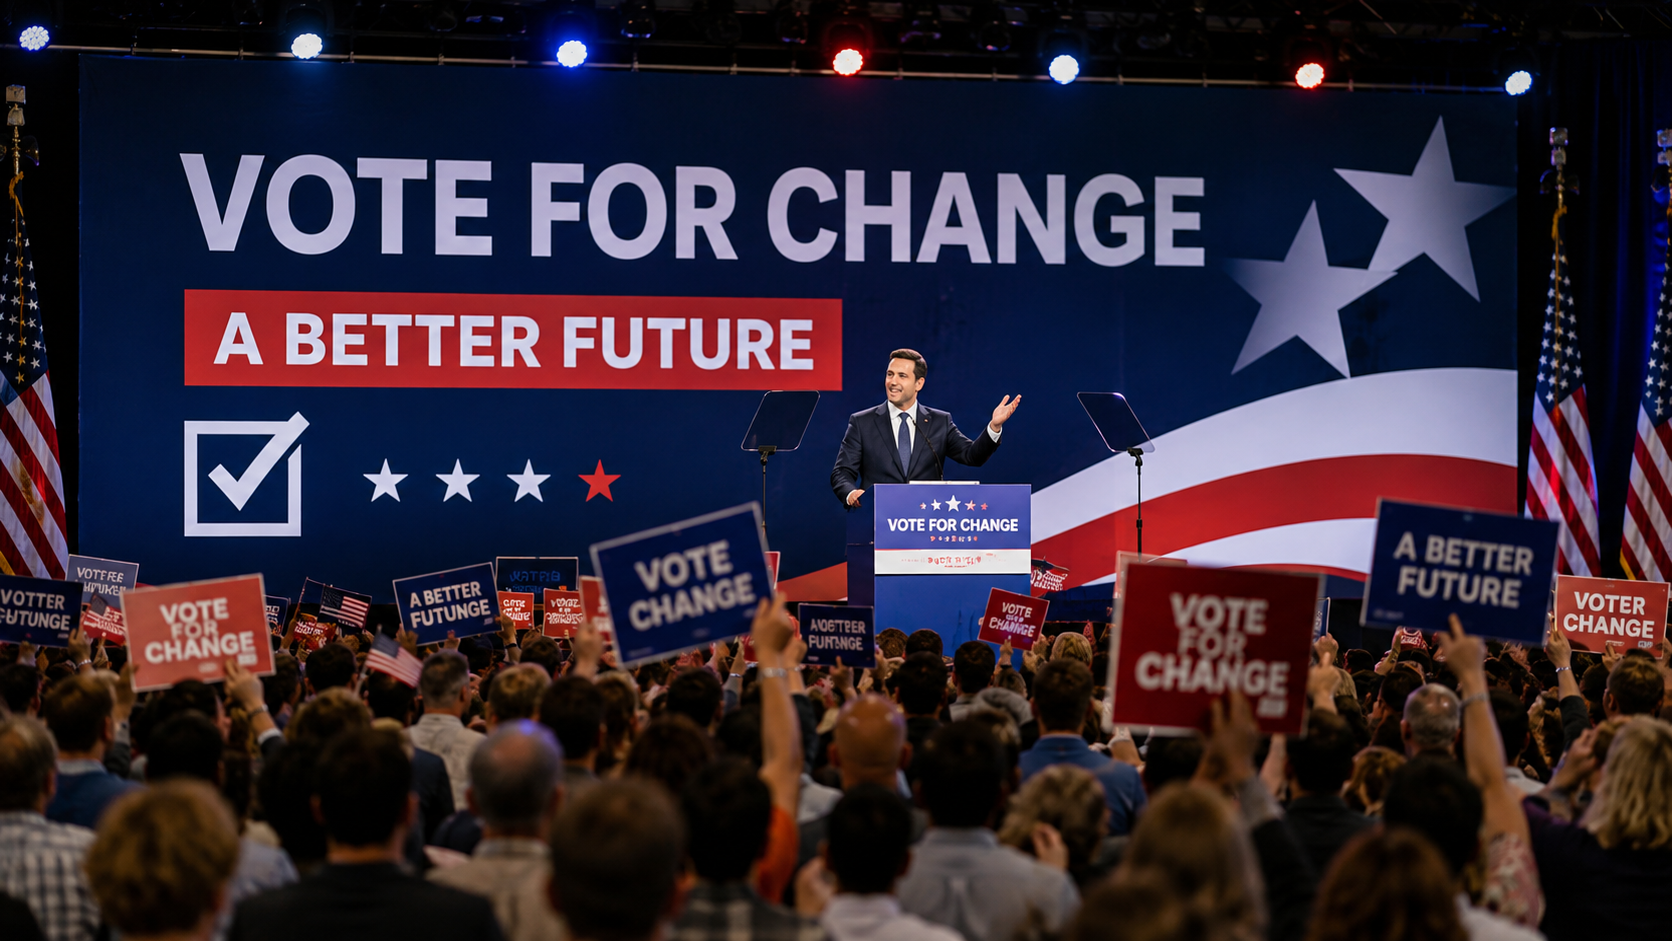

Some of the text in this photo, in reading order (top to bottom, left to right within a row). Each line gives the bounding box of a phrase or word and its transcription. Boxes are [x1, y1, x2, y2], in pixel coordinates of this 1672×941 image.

[180, 153, 1205, 267] VOTE FOR CHANGE
[213, 311, 814, 371] A BETTER FUTURE
[887, 518, 1019, 532] VOTE FOR CHANGE
[634, 539, 734, 592] VOTE
[1393, 531, 1534, 575] A BETTER
[0, 589, 65, 610] VOTTER
[409, 580, 482, 608] A BETTER
[628, 572, 756, 632] CHANGE
[1397, 565, 1521, 609] FUTURE
[1574, 591, 1646, 616] VOTER
[159, 597, 230, 626] VOTE
[409, 599, 491, 628] FUTUNGE
[1165, 592, 1269, 635] VOTE
[1563, 613, 1655, 639] CHANGE
[170, 618, 219, 641] FOR
[1176, 628, 1249, 662] FOR
[144, 630, 257, 664] CHANGE
[1134, 651, 1289, 697] CHANGE
